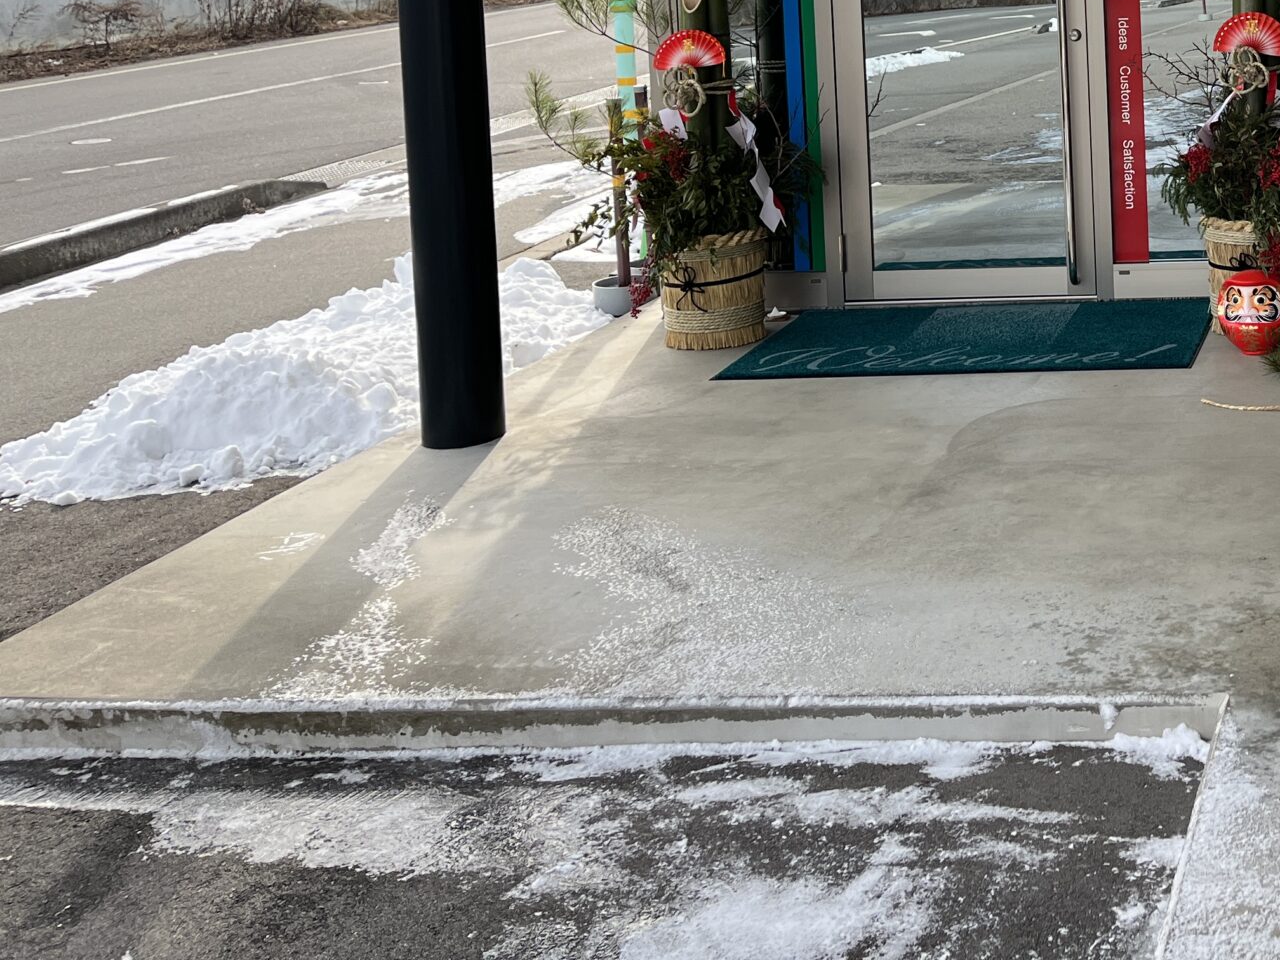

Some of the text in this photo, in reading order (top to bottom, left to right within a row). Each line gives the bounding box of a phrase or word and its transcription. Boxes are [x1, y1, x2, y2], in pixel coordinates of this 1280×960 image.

[1117, 17, 1128, 50] Ideas
[1119, 65, 1131, 125] Customer
[1122, 139, 1135, 210] Satisfaction
[751, 343, 1177, 372] Welcome!
